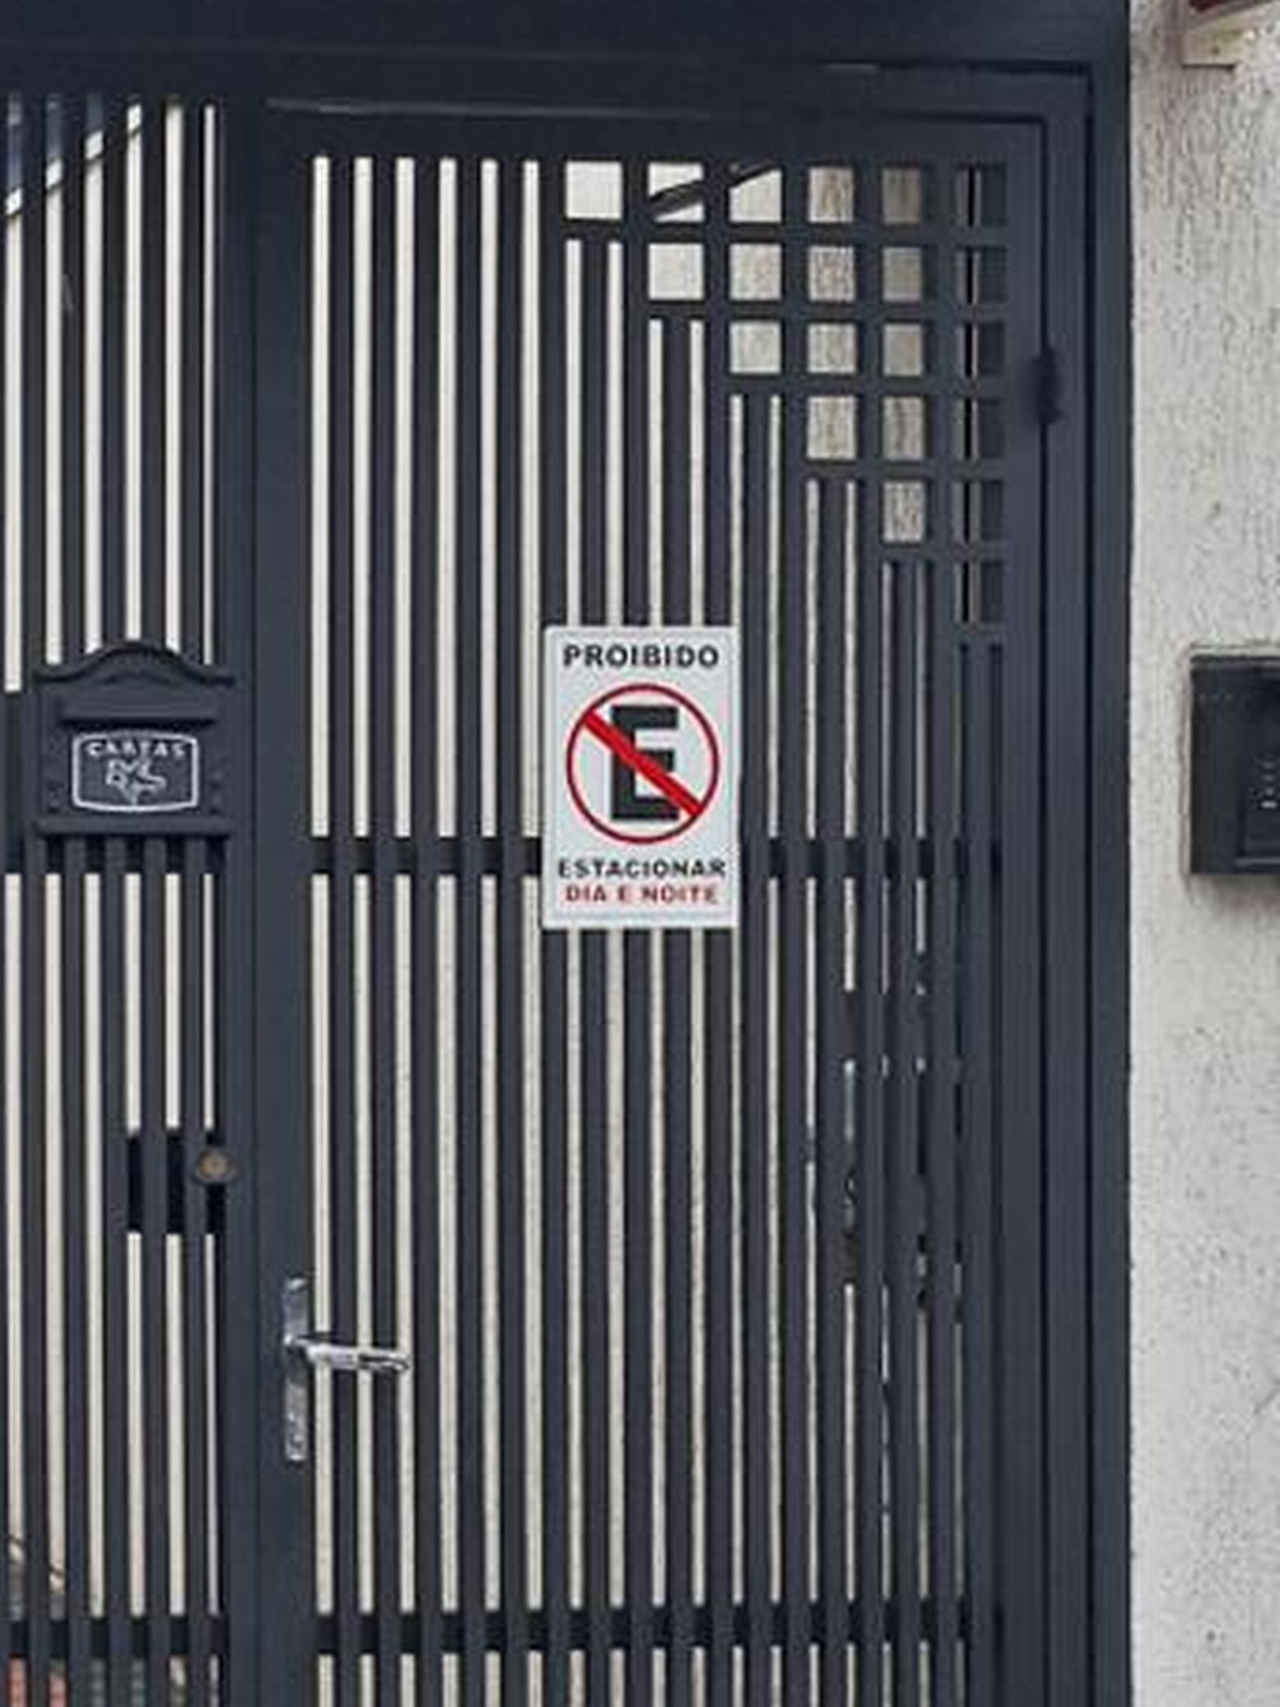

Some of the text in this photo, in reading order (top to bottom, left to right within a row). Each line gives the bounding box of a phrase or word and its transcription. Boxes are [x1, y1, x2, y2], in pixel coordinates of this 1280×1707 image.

[563, 644, 720, 668] PROIBIDO
[558, 859, 727, 879] ESTACIONAR
[565, 885, 720, 903] DIA E NOITE
